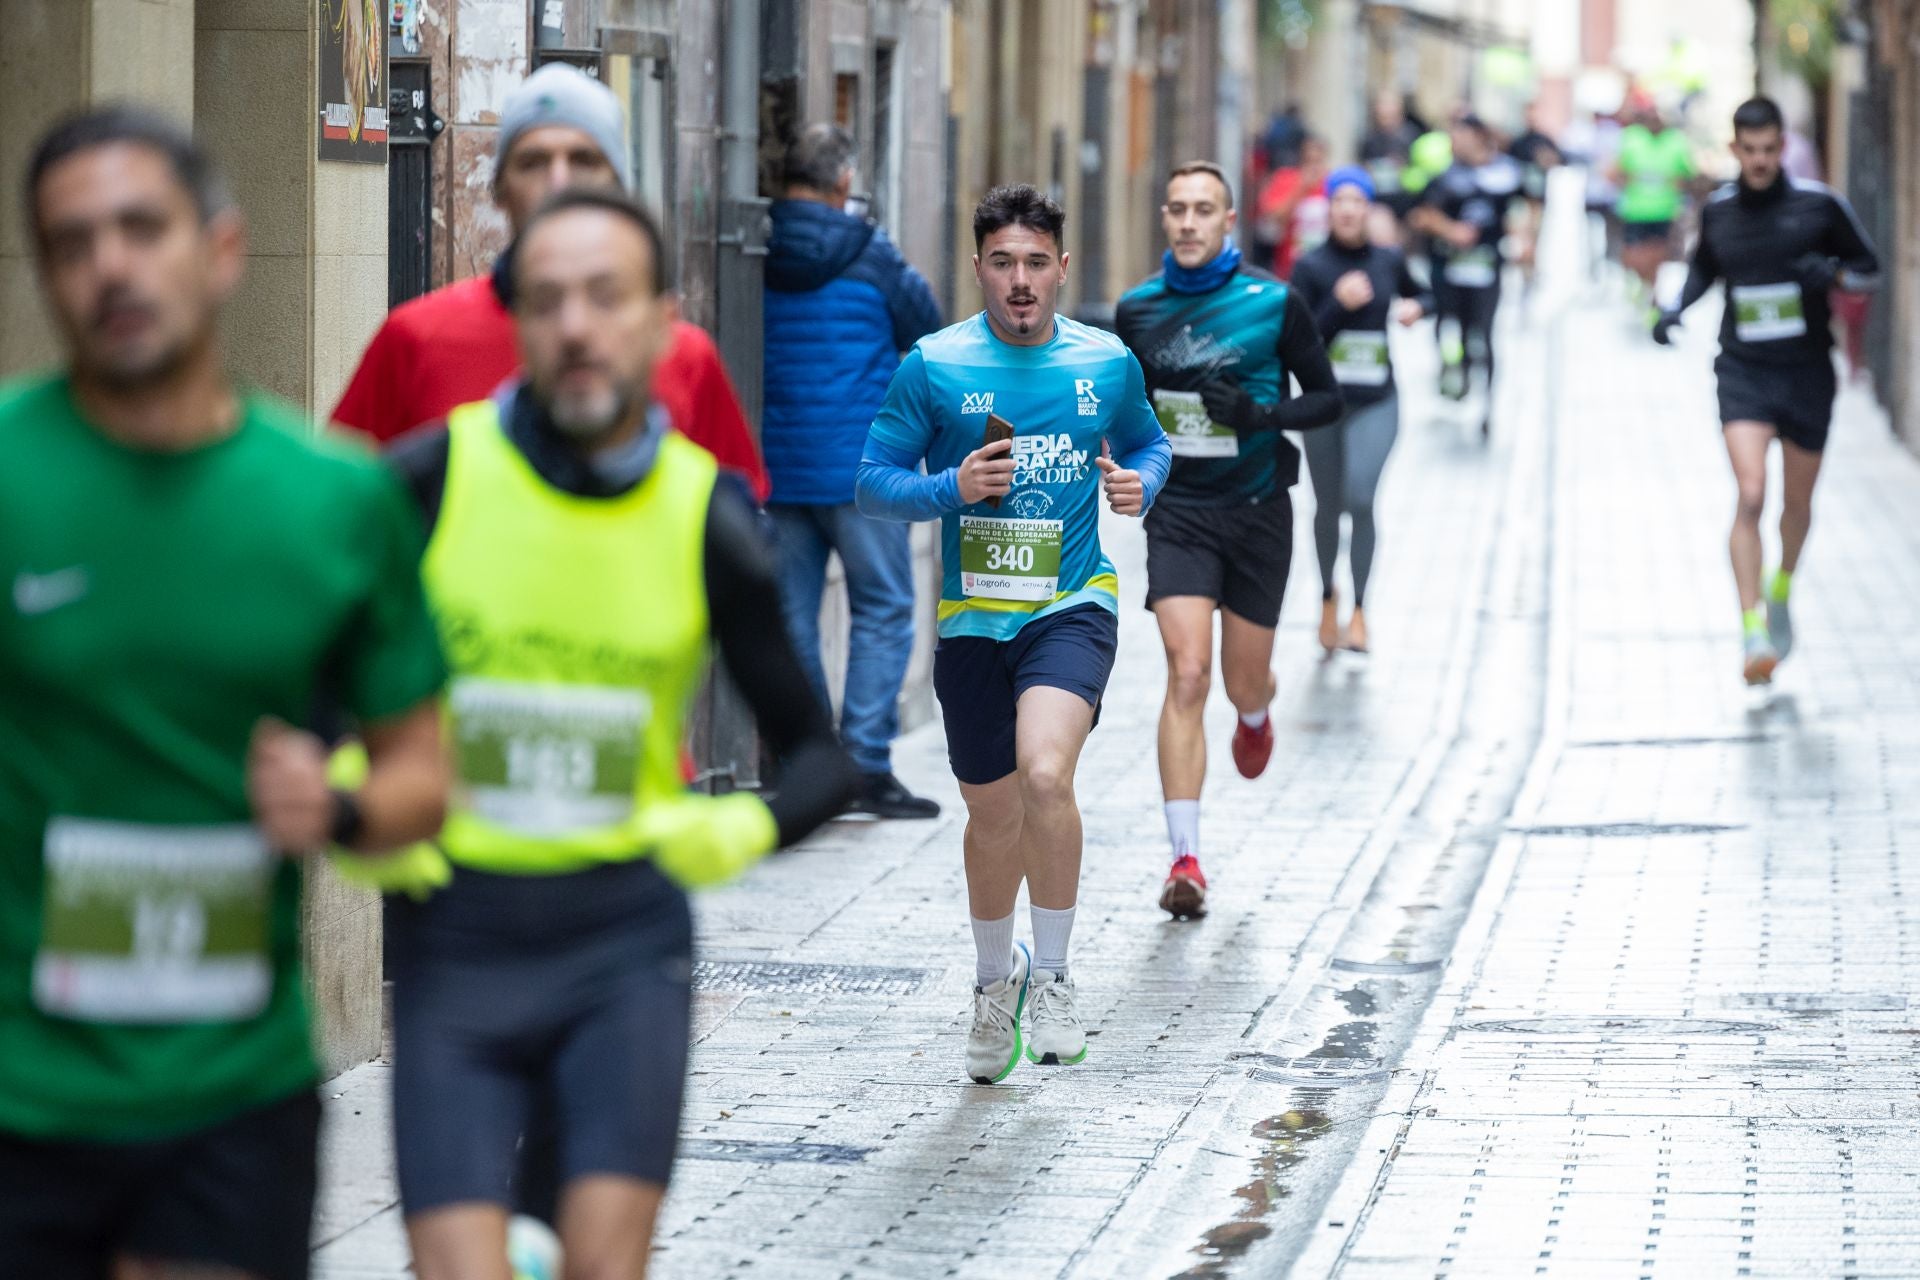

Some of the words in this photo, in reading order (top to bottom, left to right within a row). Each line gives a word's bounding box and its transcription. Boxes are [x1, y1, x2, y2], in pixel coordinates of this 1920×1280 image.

[1074, 379, 1101, 403] R
[961, 392, 995, 407] XVII
[1077, 408, 1098, 416] RIOJA
[1010, 433, 1073, 454] EDIA
[963, 519, 1009, 530] CARRERA
[1012, 522, 1060, 532] POPULAR
[965, 528, 991, 536] VIRGEN
[1015, 531, 1058, 539] ESPERANZA
[986, 544, 1034, 572] 340
[976, 578, 1011, 589] Logroño
